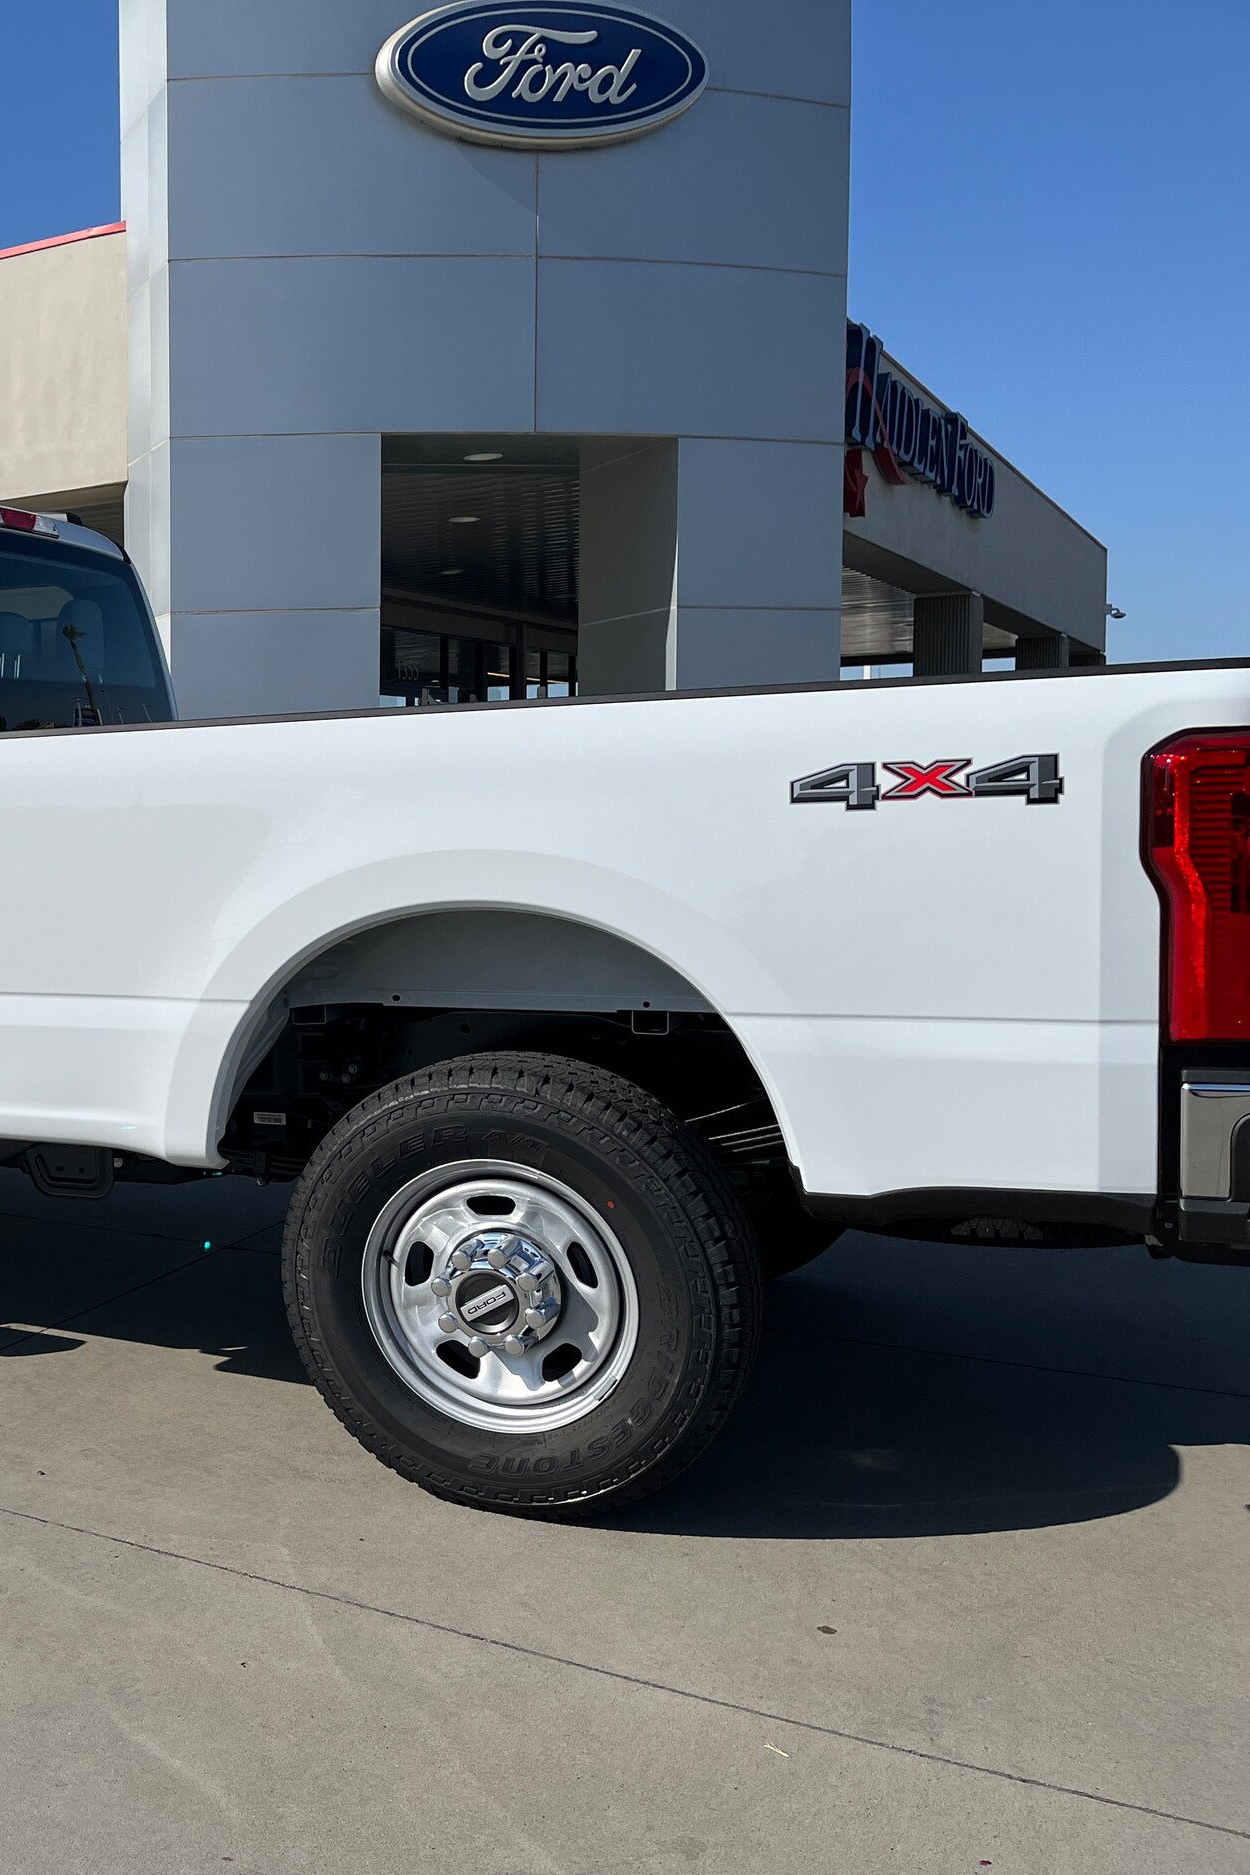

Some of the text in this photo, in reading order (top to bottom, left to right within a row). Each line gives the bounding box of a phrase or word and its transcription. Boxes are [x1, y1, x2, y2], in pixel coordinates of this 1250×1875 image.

[464, 24, 641, 104] Ford
[950, 411, 995, 518] FORD
[321, 1122, 551, 1279] DUELER A/T
[468, 1291, 506, 1315] FORD
[469, 1280, 681, 1477] BRIDGESTONE
